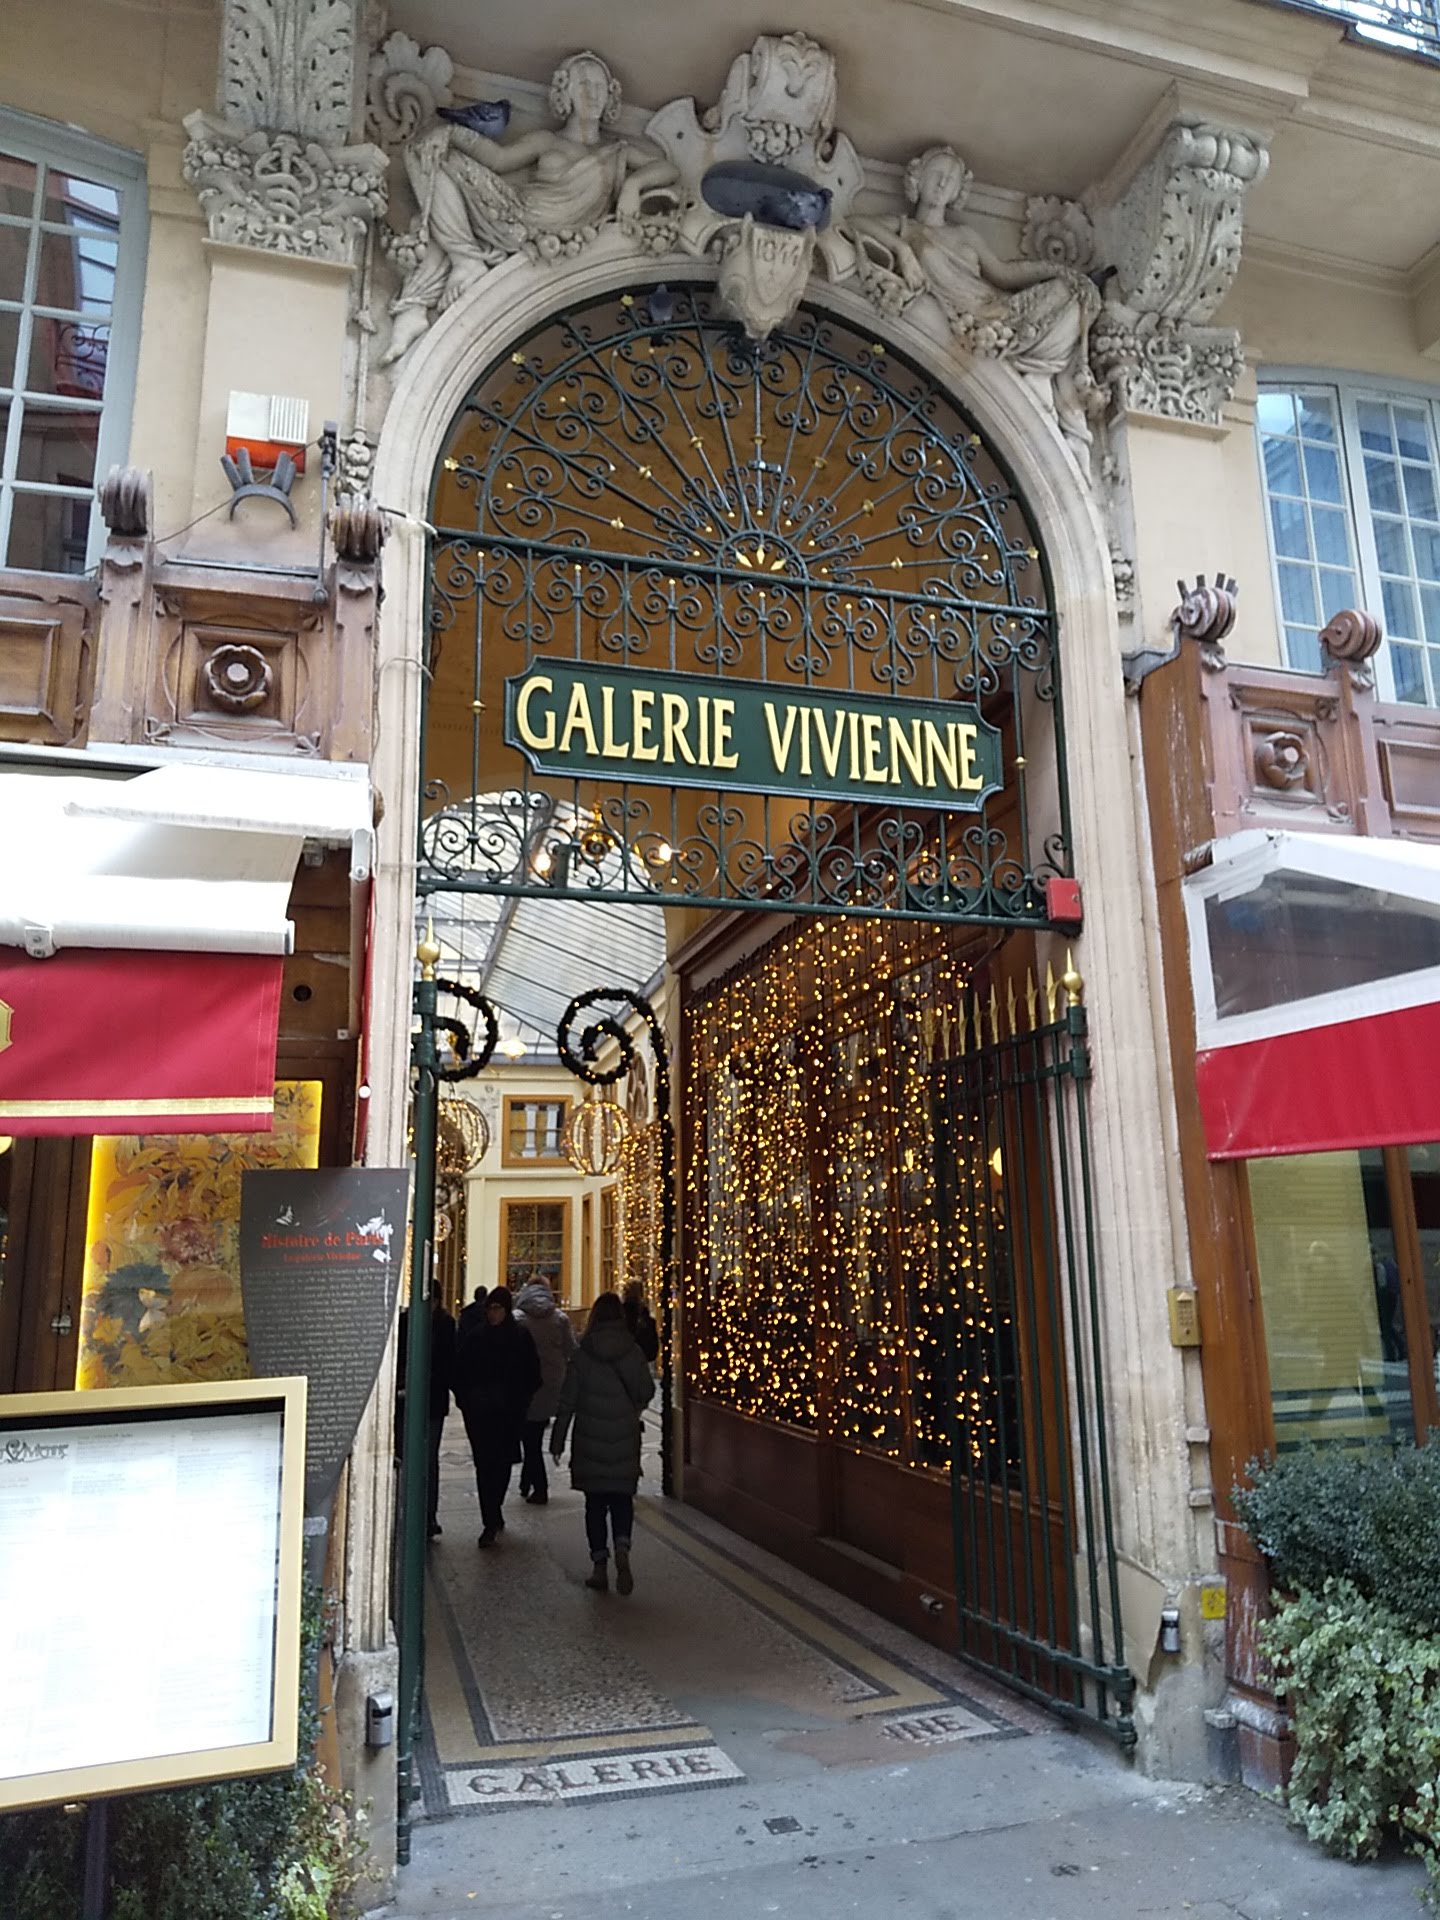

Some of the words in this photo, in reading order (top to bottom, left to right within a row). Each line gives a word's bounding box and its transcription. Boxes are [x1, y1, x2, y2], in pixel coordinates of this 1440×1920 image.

[516, 675, 740, 770] GALERIE
[763, 702, 985, 791] VIVIENNE
[261, 1231, 320, 1249] Histoire
[324, 1231, 341, 1248] de
[467, 1753, 721, 1796] GALERIE
